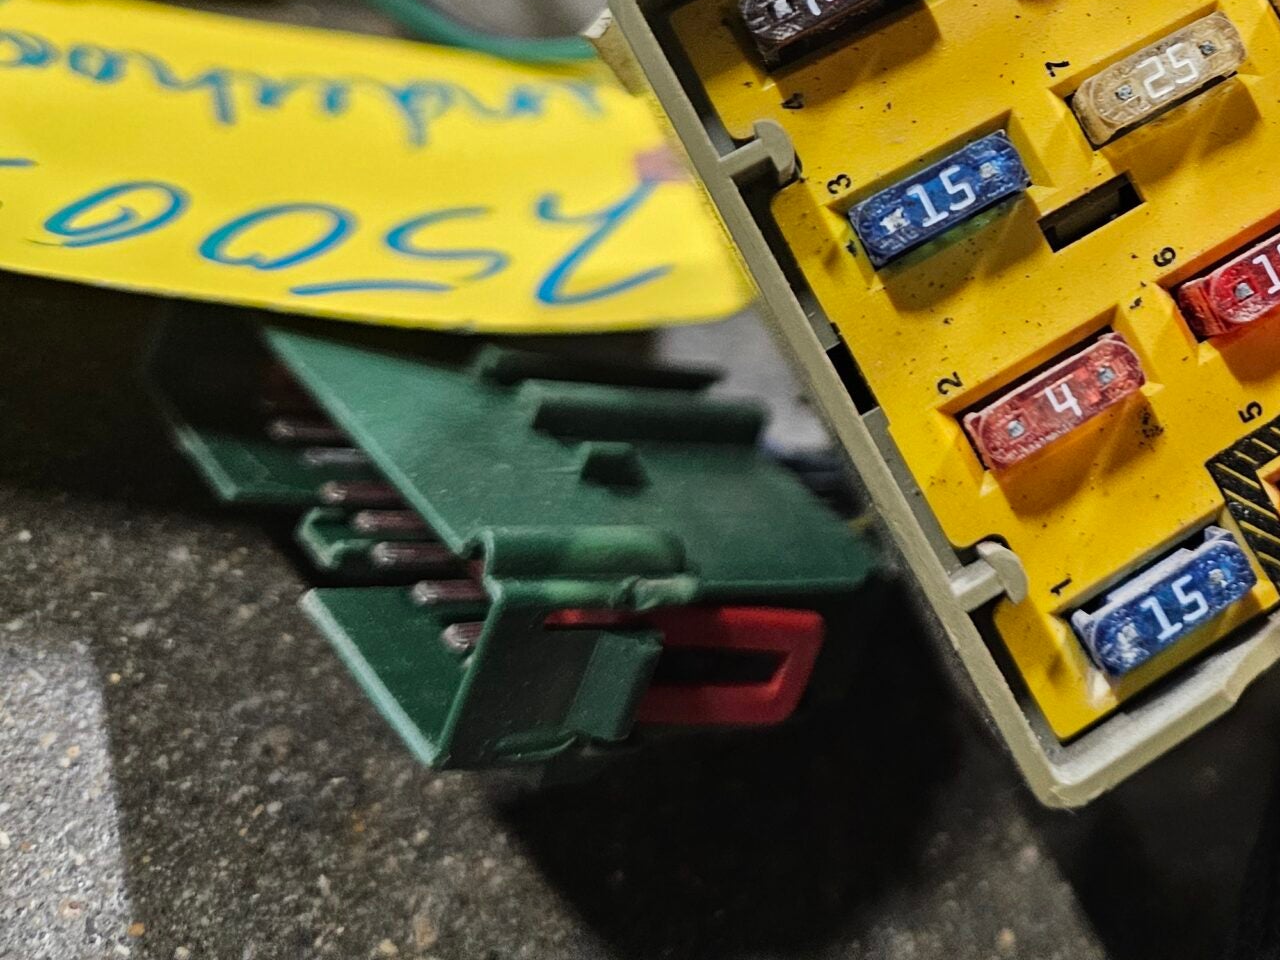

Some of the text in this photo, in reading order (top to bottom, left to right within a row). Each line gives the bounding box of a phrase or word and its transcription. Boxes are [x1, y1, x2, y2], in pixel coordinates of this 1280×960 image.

[1045, 60, 1070, 78] 7
[1138, 42, 1198, 98] 25
[827, 173, 852, 195] 3
[907, 166, 977, 228] 15
[1154, 247, 1176, 267] 6
[938, 372, 962, 395] 2
[1044, 383, 1082, 420] 4
[1239, 401, 1263, 424] 5
[1050, 578, 1073, 596] 1
[1140, 575, 1209, 640] 15
